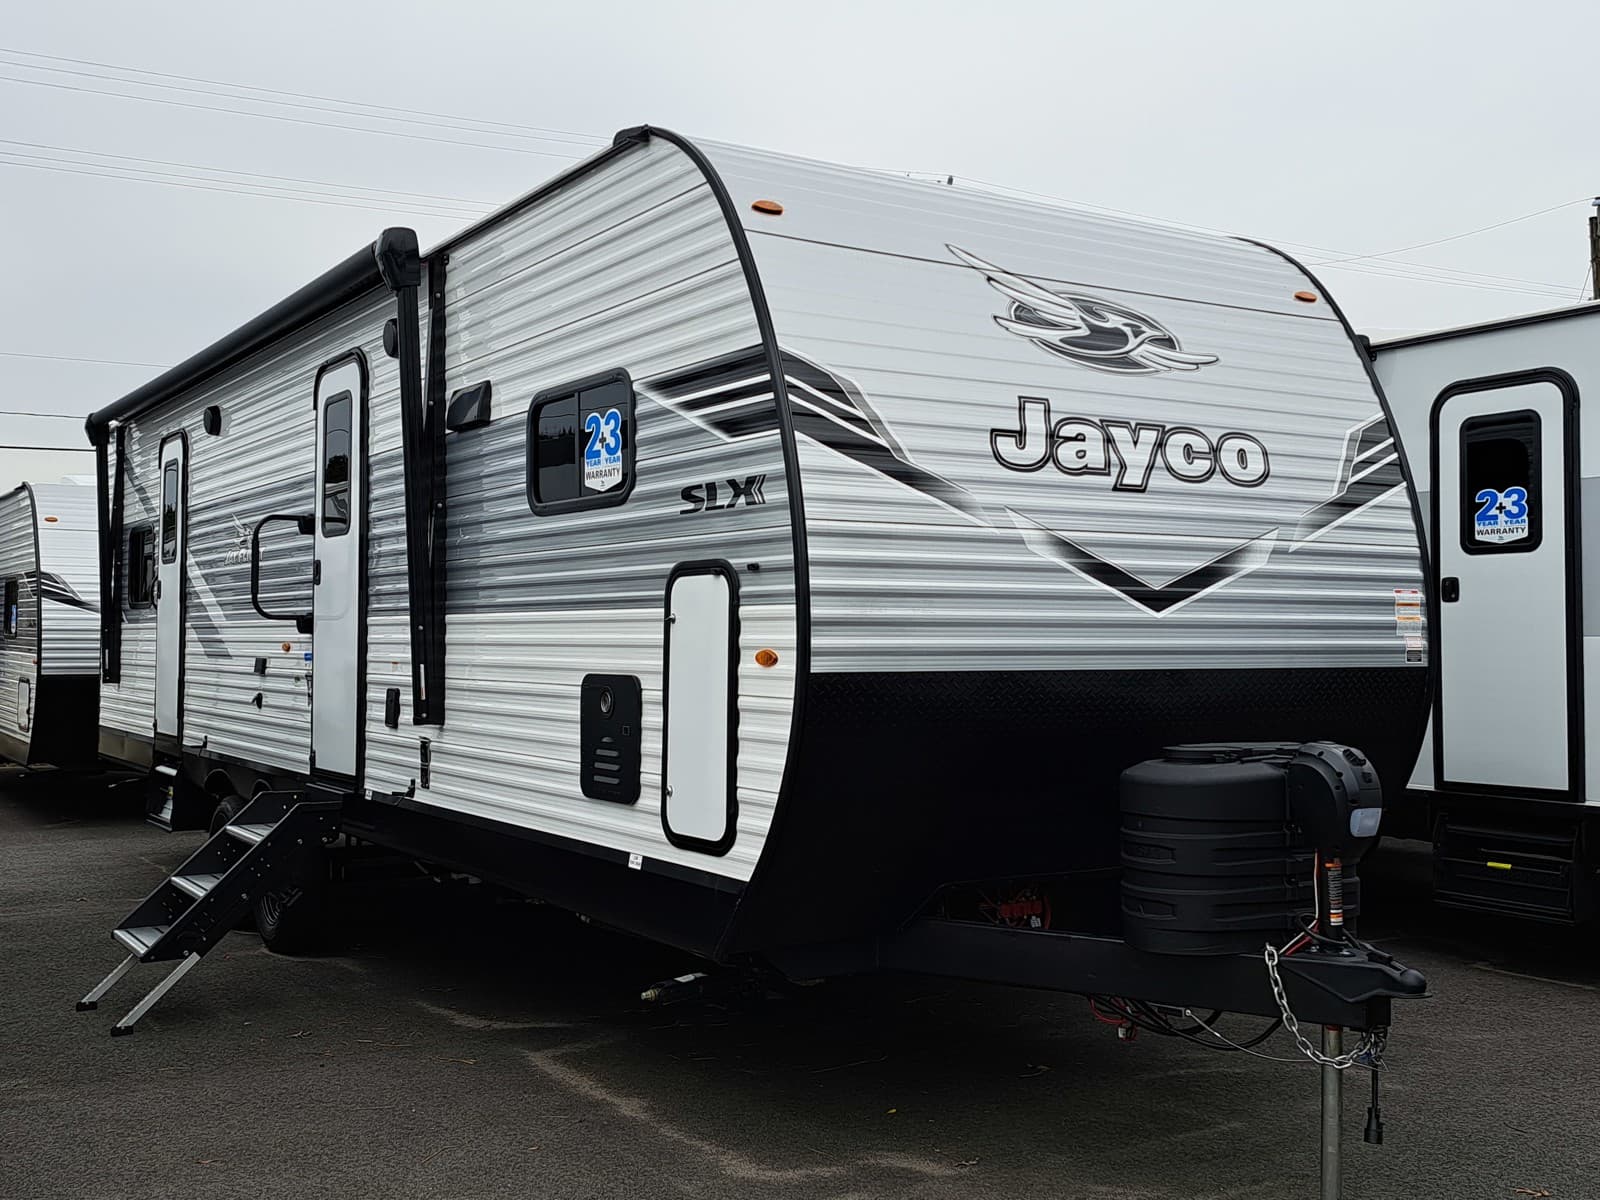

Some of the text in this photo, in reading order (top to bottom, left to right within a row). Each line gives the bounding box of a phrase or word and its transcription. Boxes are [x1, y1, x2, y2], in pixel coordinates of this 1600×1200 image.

[990, 396, 1270, 492] Jayco
[586, 456, 620, 467] YEAR YEAR
[586, 468, 620, 480] WARRANTY
[680, 474, 766, 514] SLX
[1477, 527, 1526, 536] WARRANTY
